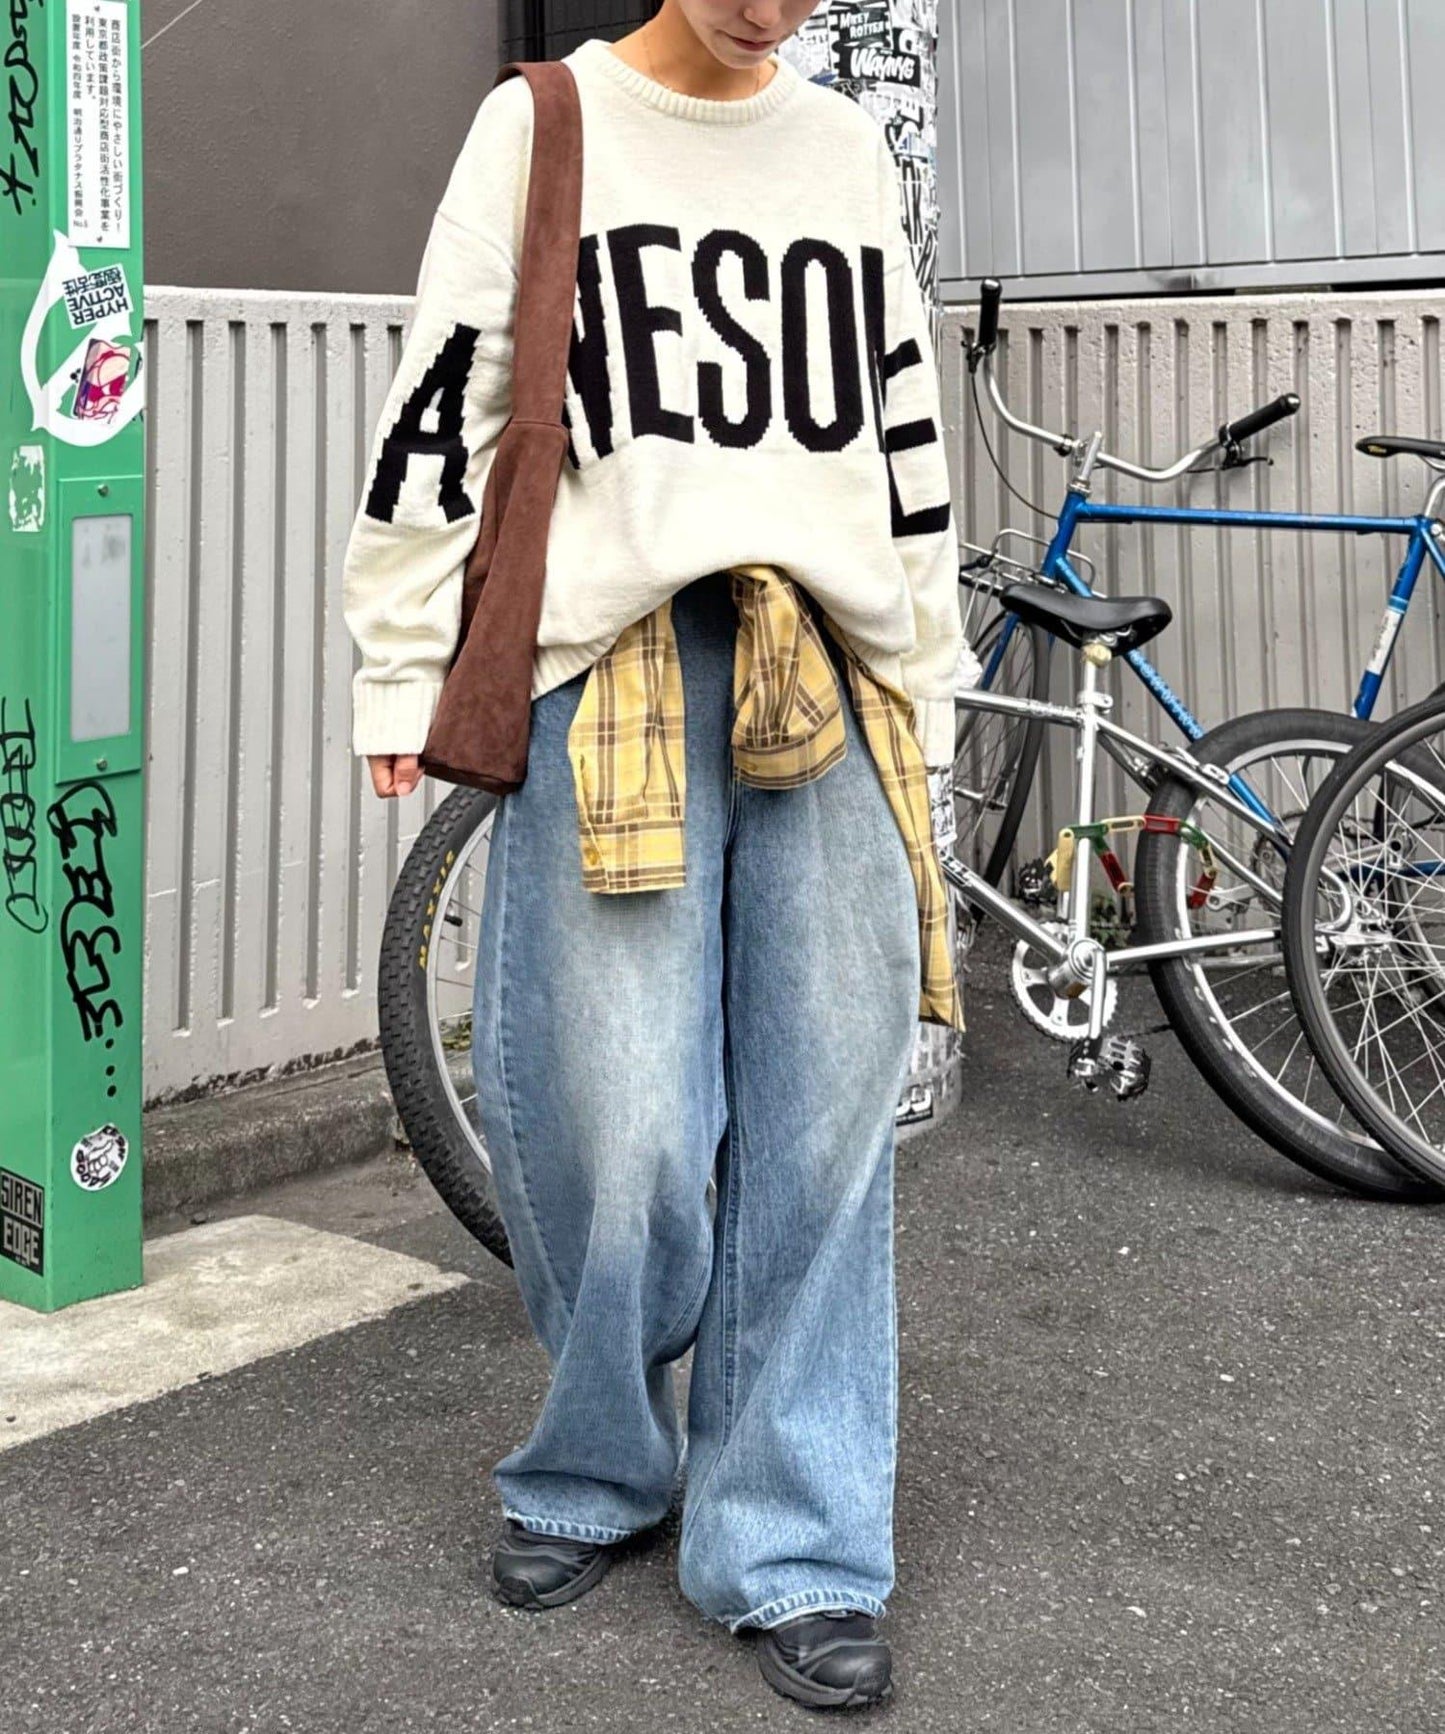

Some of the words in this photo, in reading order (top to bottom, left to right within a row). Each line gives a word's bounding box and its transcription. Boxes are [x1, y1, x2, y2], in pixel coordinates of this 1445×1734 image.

[85, 16, 97, 100] 利用しています。
[67, 283, 124, 312] ACTIVE
[71, 297, 129, 326] HYPER
[1, 1174, 43, 1226] SIREN
[3, 1215, 40, 1265] EDGE
